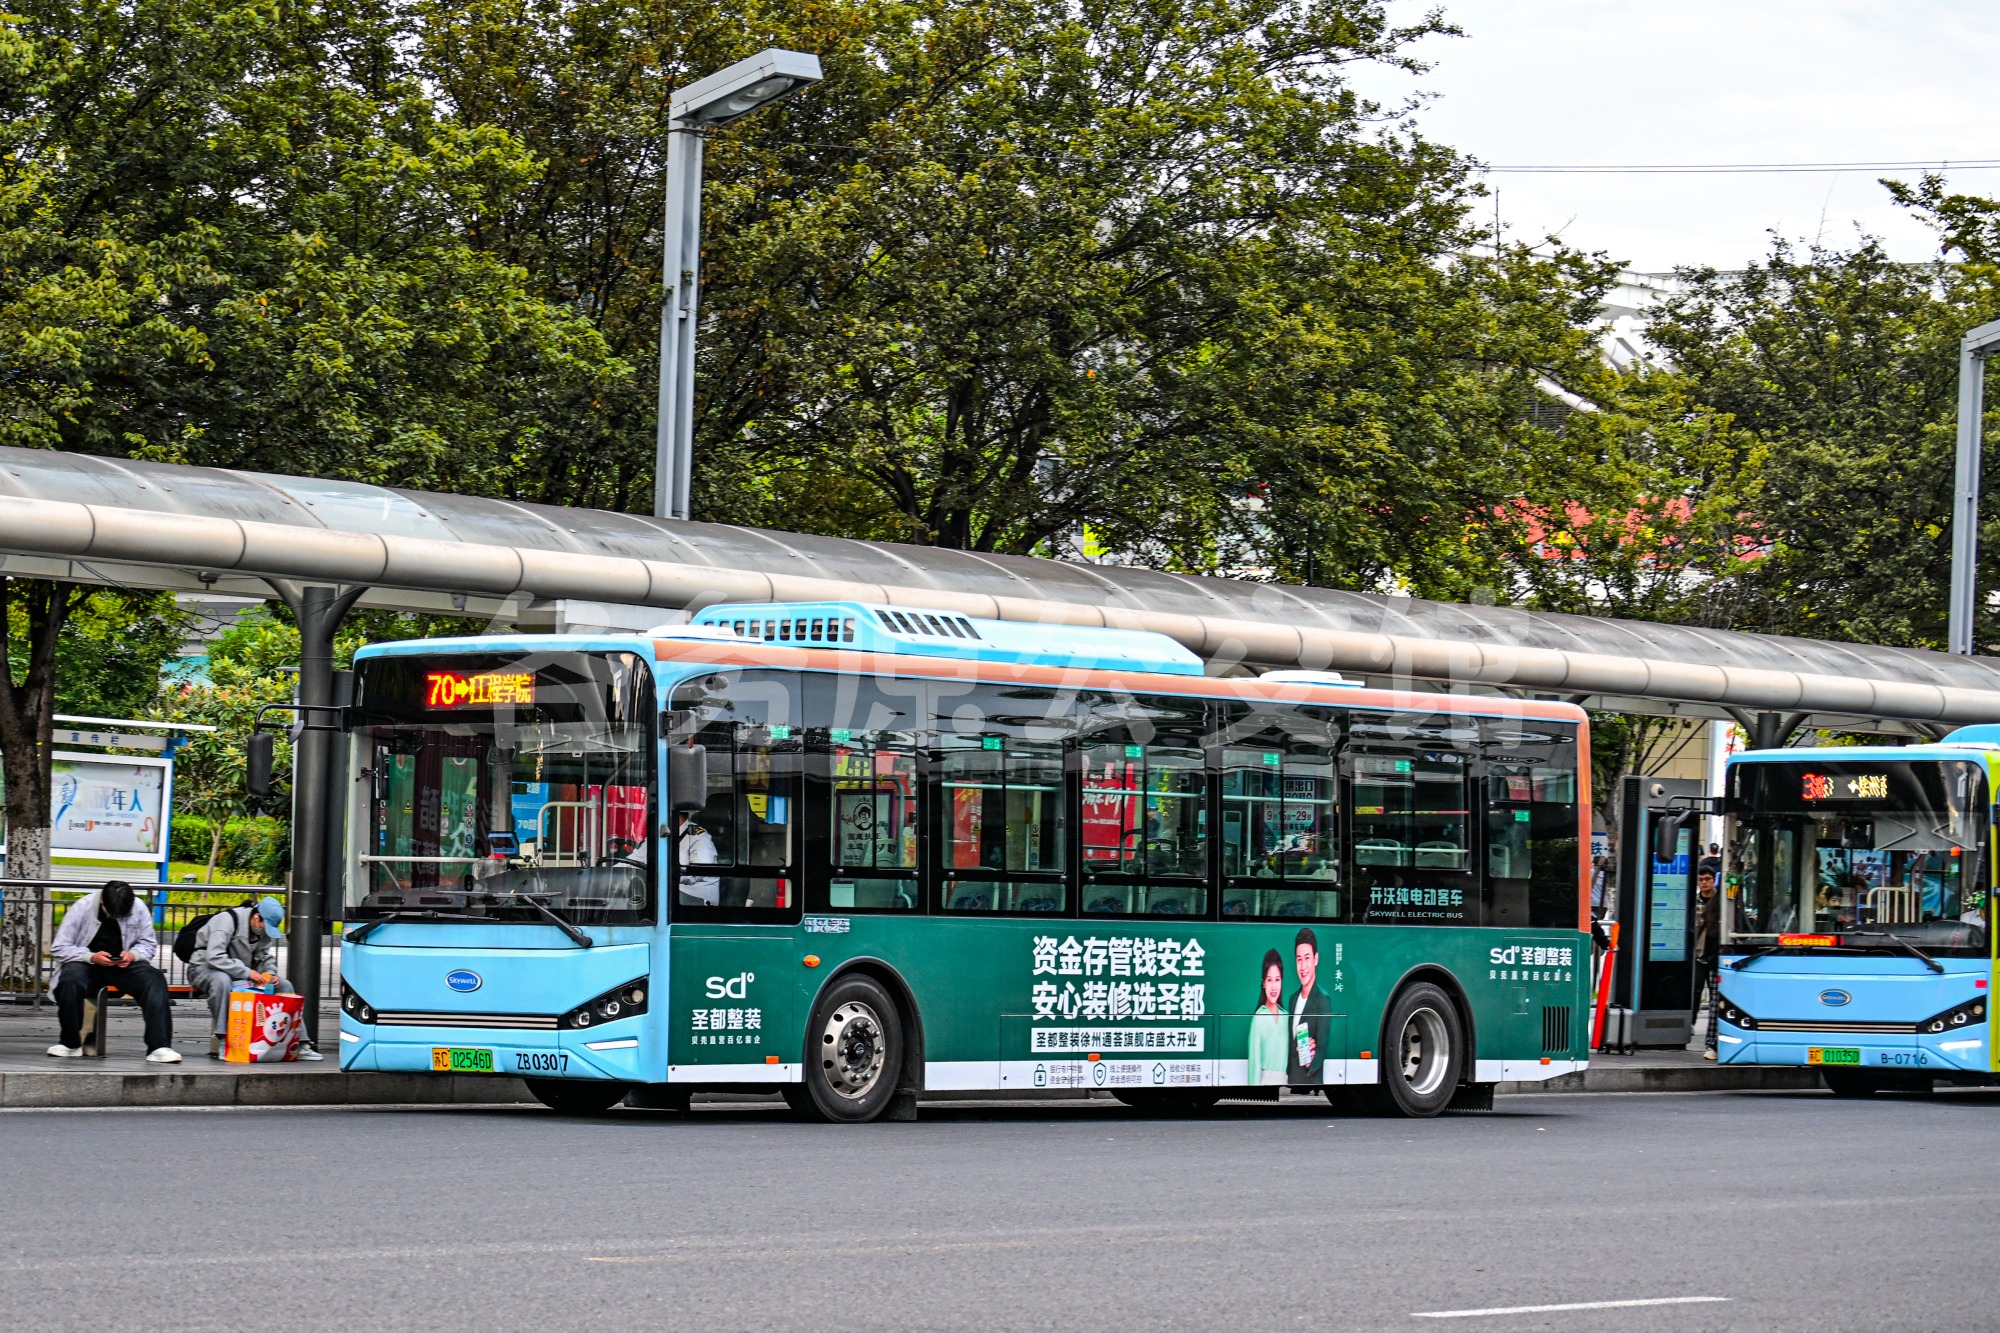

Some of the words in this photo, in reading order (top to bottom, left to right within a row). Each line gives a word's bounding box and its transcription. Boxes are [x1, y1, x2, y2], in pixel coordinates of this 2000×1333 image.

[427, 674, 456, 705] 70
[71, 732, 120, 746] 宣传栏
[1370, 887, 1463, 906] 开沃纯电动客车
[1032, 935, 1206, 977] 资金存管钱安全
[1521, 946, 1572, 966] 圣都整装
[1031, 981, 1206, 1021] 安心装修选圣都
[691, 1008, 762, 1030] 圣都整装
[691, 1035, 761, 1045] 贝壳直营百亿装企
[1035, 1031, 1198, 1048] 圣都整装徐州通荟旗舰店盛大开业
[515, 1053, 569, 1072] ZB0307
[1881, 1053, 1928, 1066] B-0716
